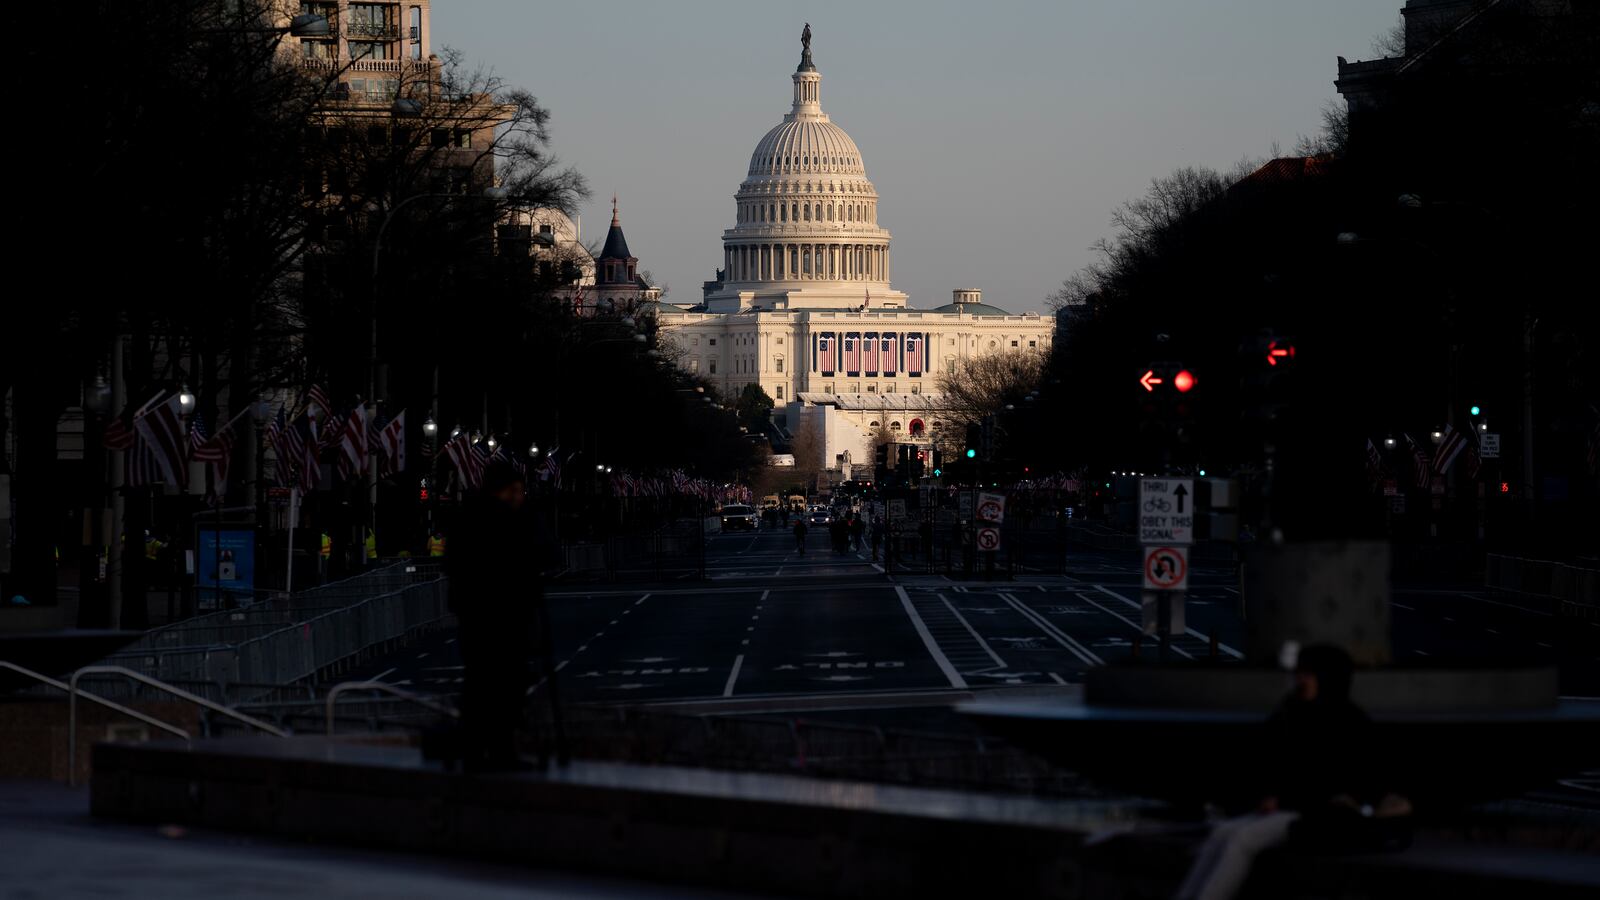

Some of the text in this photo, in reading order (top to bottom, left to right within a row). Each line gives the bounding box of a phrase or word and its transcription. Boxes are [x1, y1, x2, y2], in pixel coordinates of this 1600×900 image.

[1143, 481, 1168, 493] THRU
[1142, 516, 1192, 527] OBEY THIS
[1142, 529, 1175, 540] SIGNAL
[772, 660, 906, 671] ONLY
